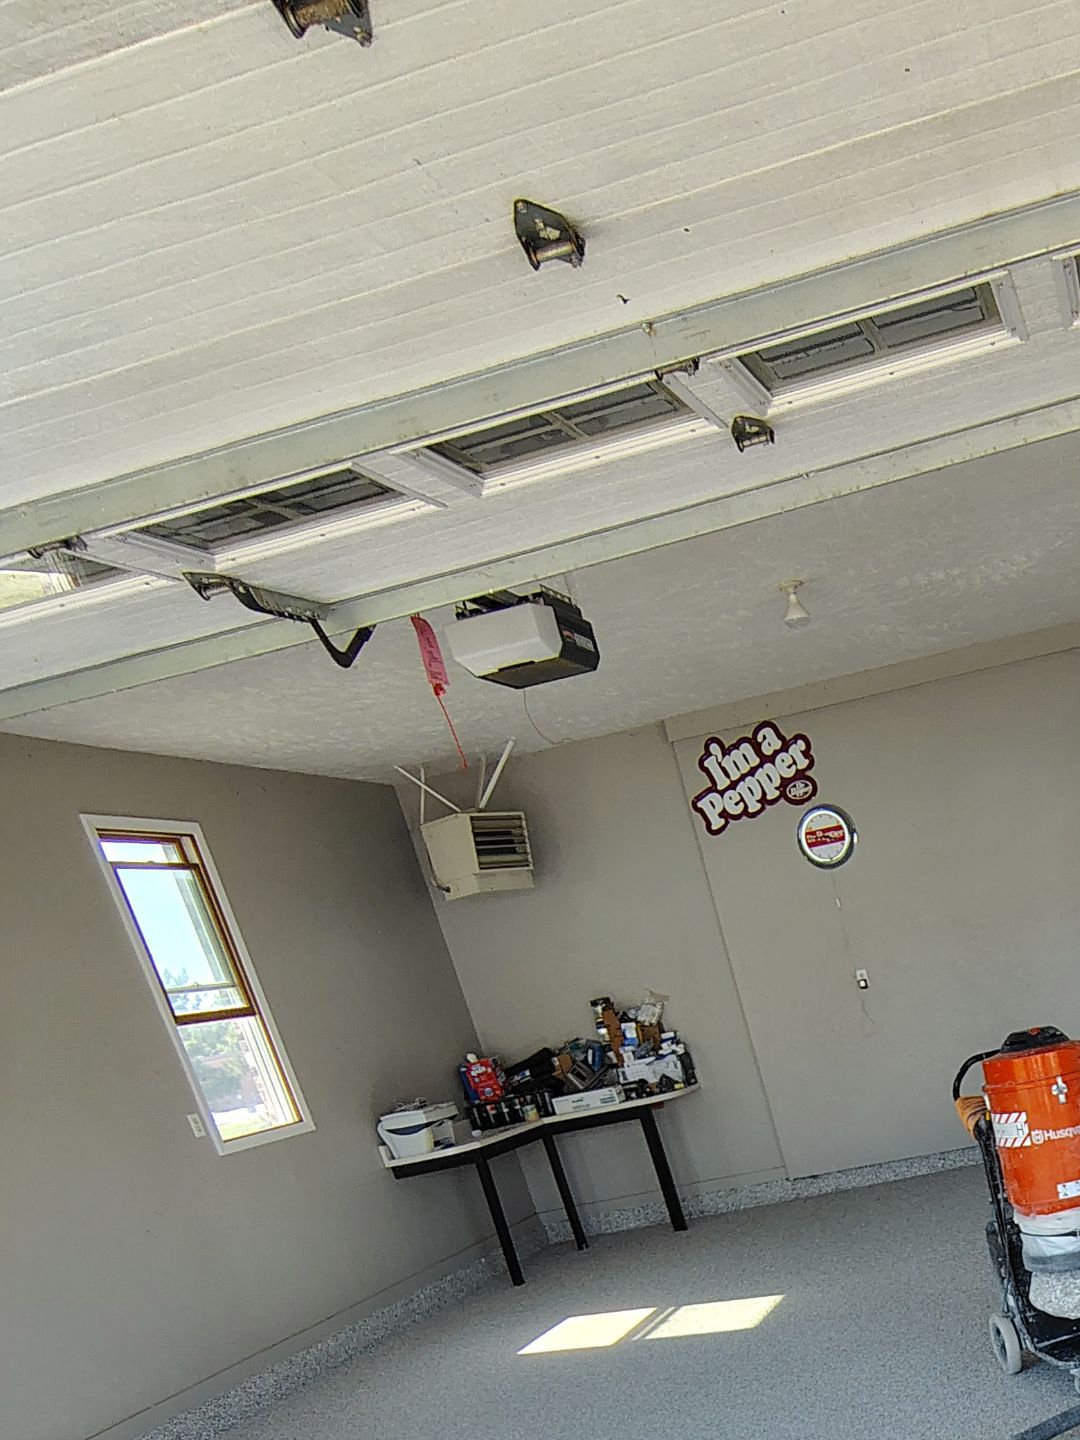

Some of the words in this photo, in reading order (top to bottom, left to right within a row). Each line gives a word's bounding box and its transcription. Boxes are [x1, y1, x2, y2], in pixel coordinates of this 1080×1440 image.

[696, 739, 810, 831] Pepper
[703, 742, 760, 790] I'm
[757, 726, 782, 756] a
